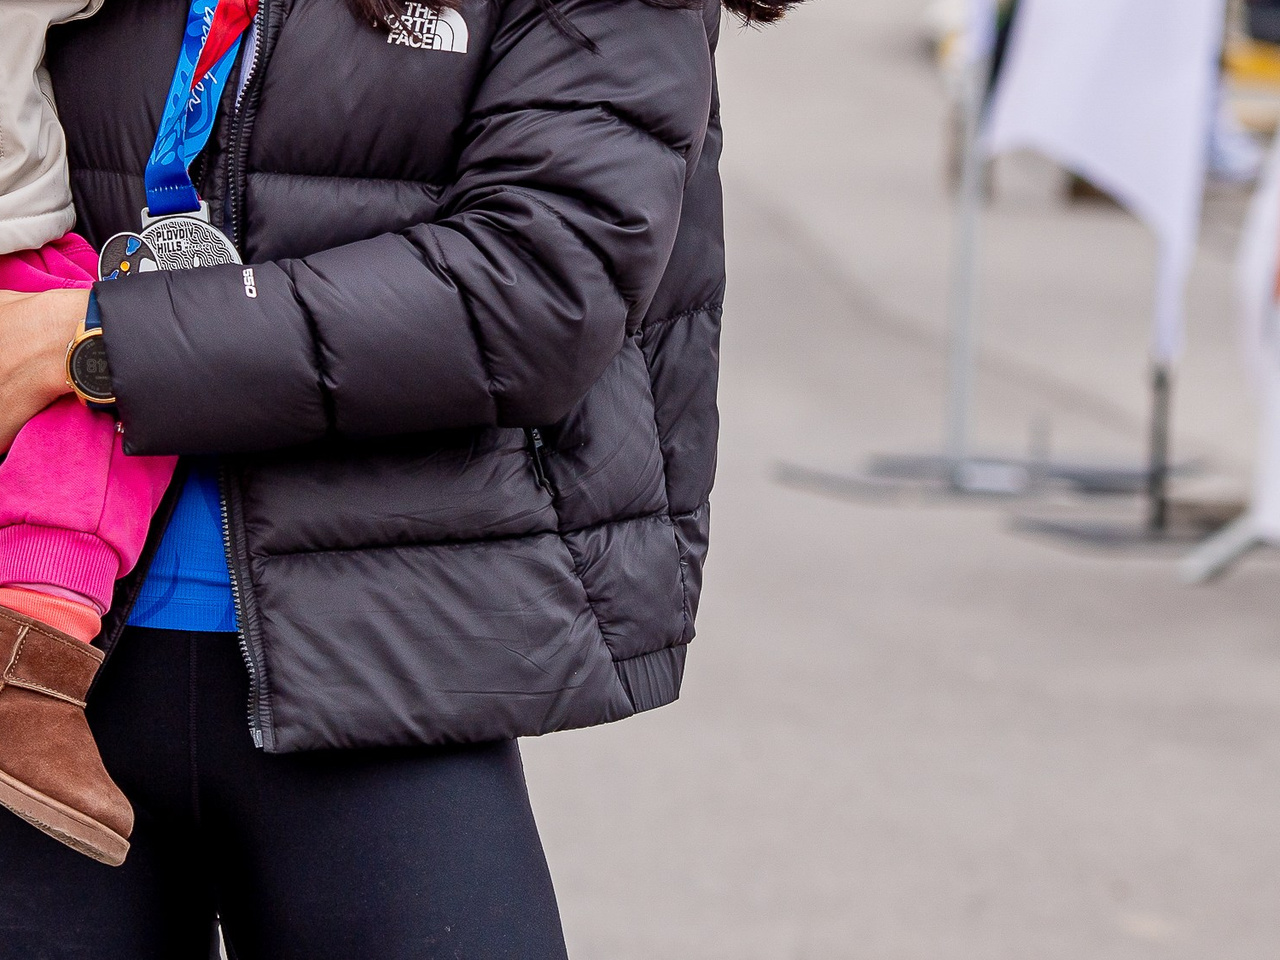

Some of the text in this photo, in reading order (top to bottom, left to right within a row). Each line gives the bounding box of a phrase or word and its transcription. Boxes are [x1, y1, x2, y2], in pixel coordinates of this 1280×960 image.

[405, 1, 438, 20] THE
[383, 12, 437, 35] ORTH
[387, 29, 434, 50] FACE
[155, 227, 194, 242] PLOVDIV
[157, 240, 183, 254] HILLS
[242, 268, 258, 298] 550
